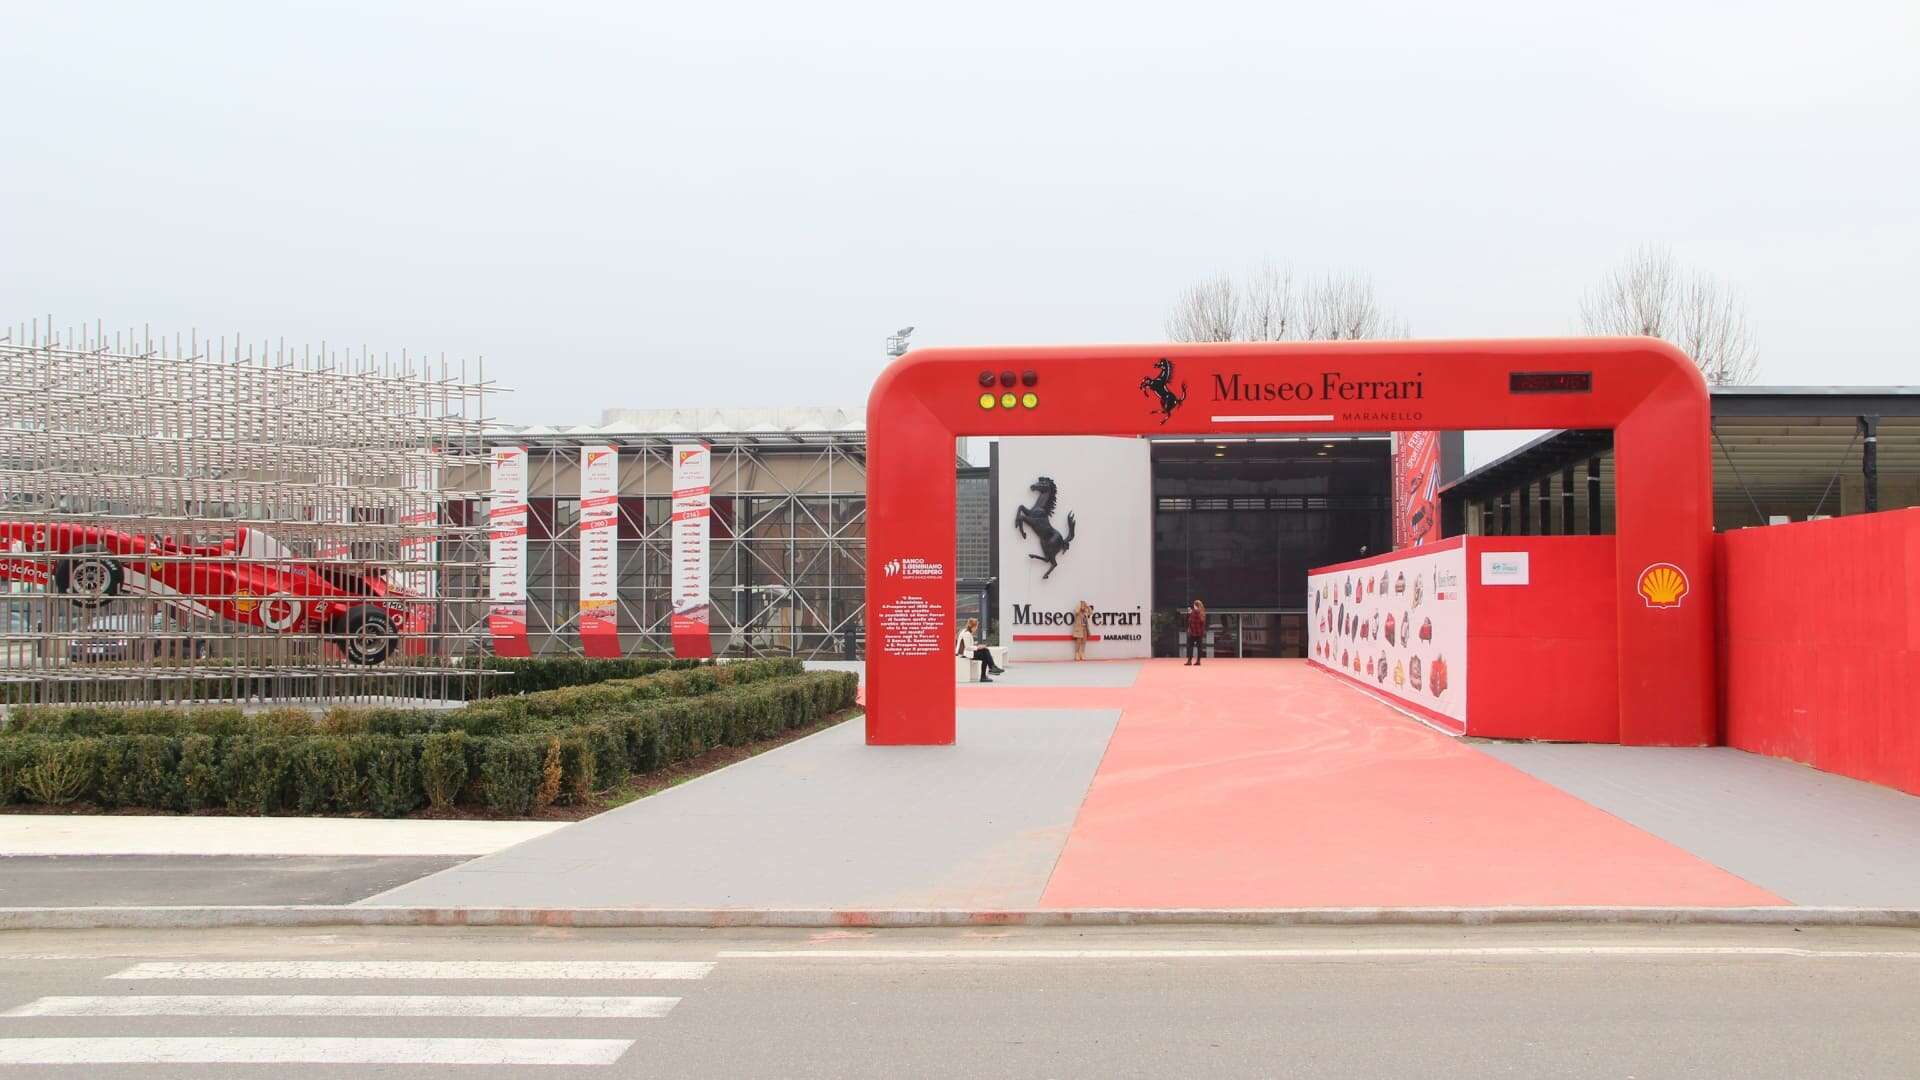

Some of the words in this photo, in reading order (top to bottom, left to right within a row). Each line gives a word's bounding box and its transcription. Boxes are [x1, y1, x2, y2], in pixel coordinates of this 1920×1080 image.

[1211, 373, 1313, 401] Museo
[1320, 372, 1423, 400] Ferrari
[1342, 412, 1423, 421] MARANELLO
[1012, 604, 1075, 625] Museo
[1088, 605, 1141, 625] errari
